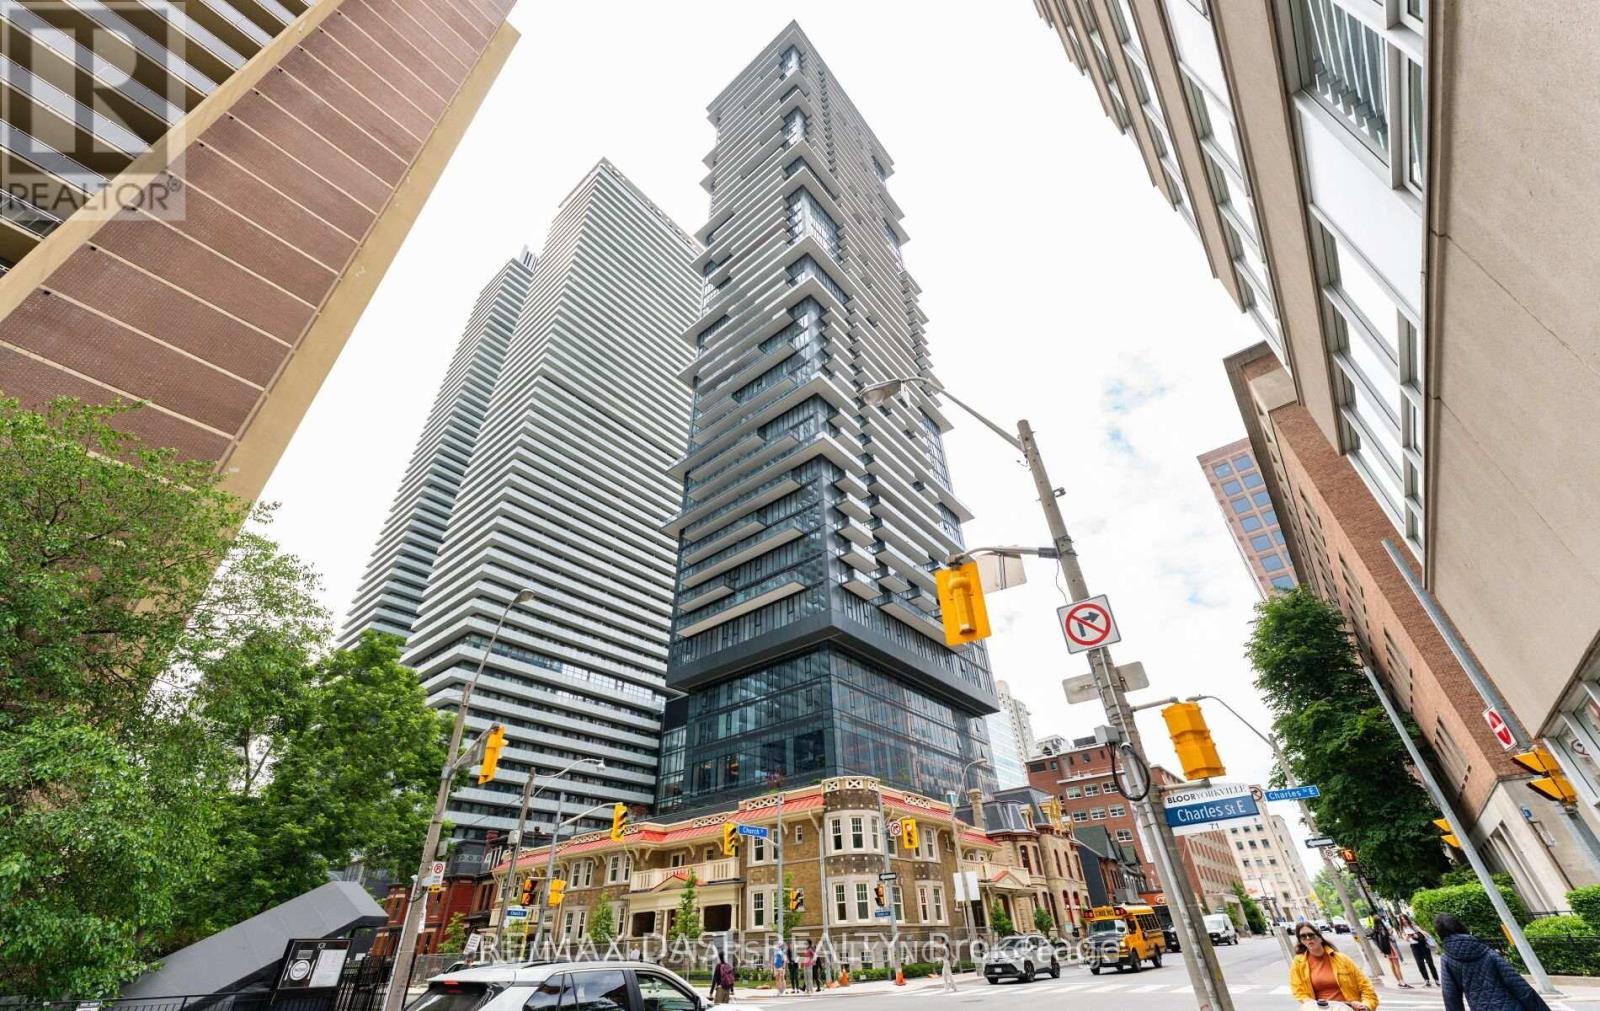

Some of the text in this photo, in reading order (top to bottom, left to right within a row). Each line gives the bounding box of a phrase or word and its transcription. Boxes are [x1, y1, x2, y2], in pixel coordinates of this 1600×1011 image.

[1268, 790, 1302, 800] Charles
[1309, 787, 1316, 795] E
[1177, 800, 1247, 822] Charles St E
[742, 826, 760, 835] Church
